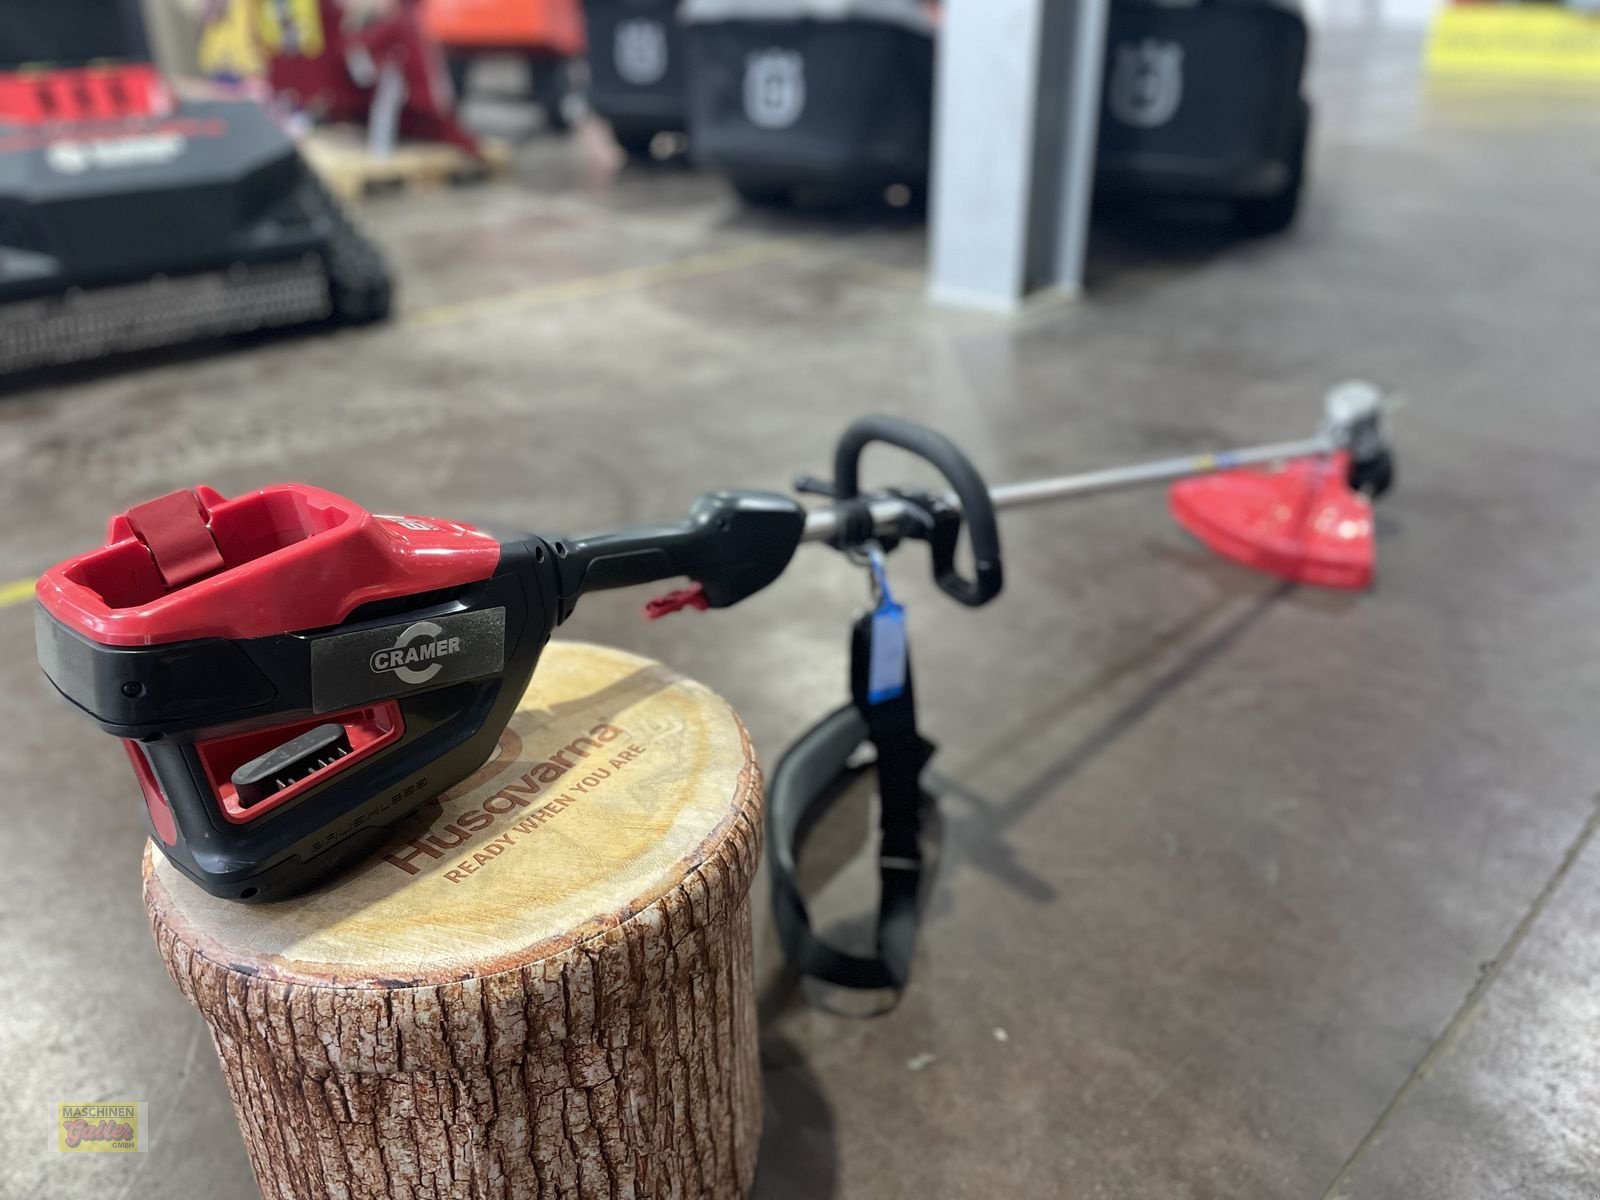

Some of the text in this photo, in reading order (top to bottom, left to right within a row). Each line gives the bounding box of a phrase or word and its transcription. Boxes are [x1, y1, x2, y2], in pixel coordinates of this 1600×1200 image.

[374, 637, 460, 670] CRAMER
[382, 721, 624, 876] Husqvarna
[443, 742, 647, 884] READY WHEN YOU ARE
